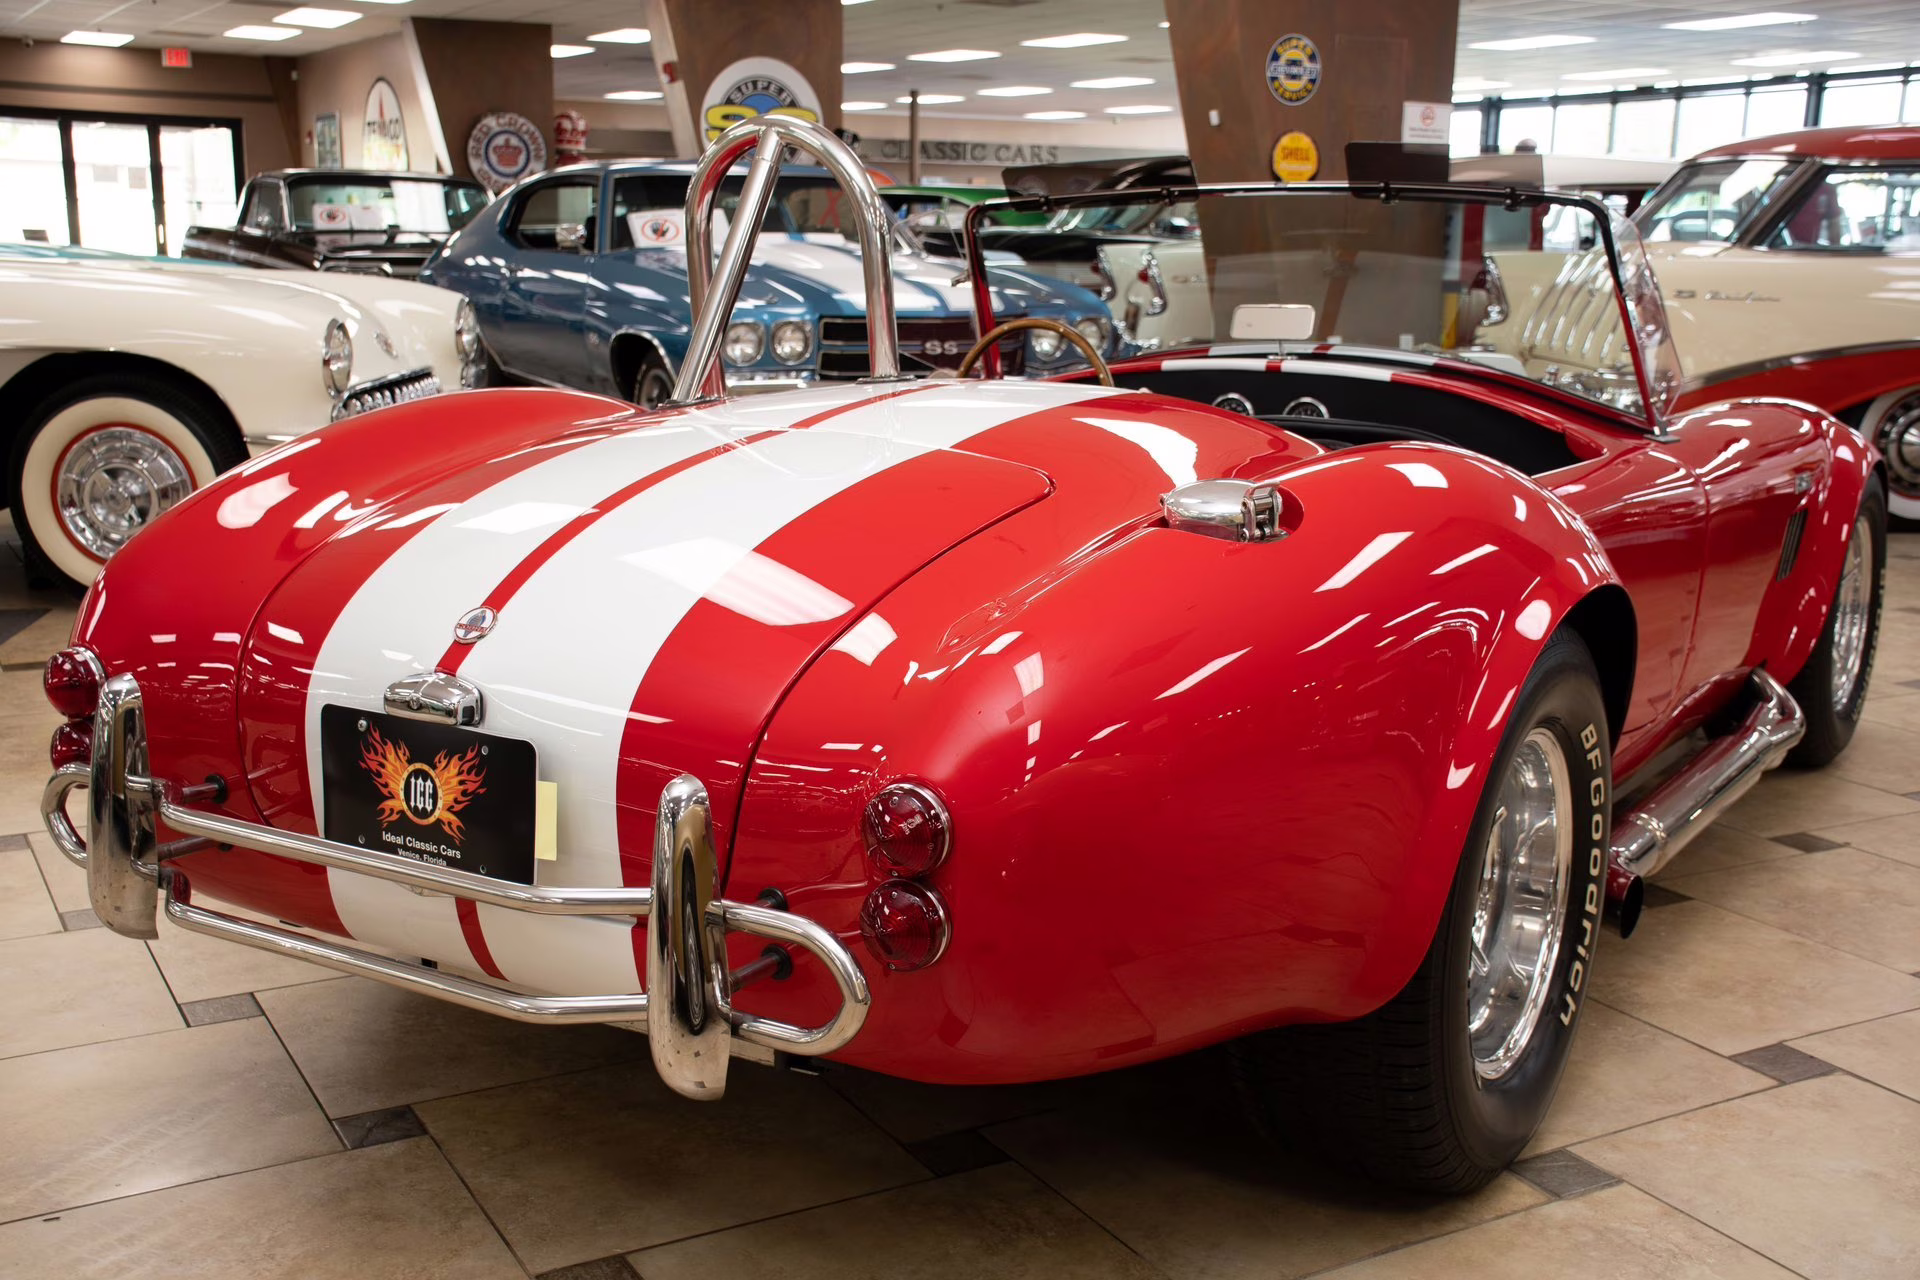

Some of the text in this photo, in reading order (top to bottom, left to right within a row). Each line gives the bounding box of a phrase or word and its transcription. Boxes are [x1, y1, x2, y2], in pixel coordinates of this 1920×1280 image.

[730, 79, 793, 106] SUPER
[471, 113, 545, 161] RED CROWN
[880, 140, 987, 162] CLASSIC
[994, 144, 1059, 164] CARS
[924, 340, 958, 356] SS
[382, 831, 461, 859] Ideal Classic Cars
[423, 854, 447, 866] Florida
